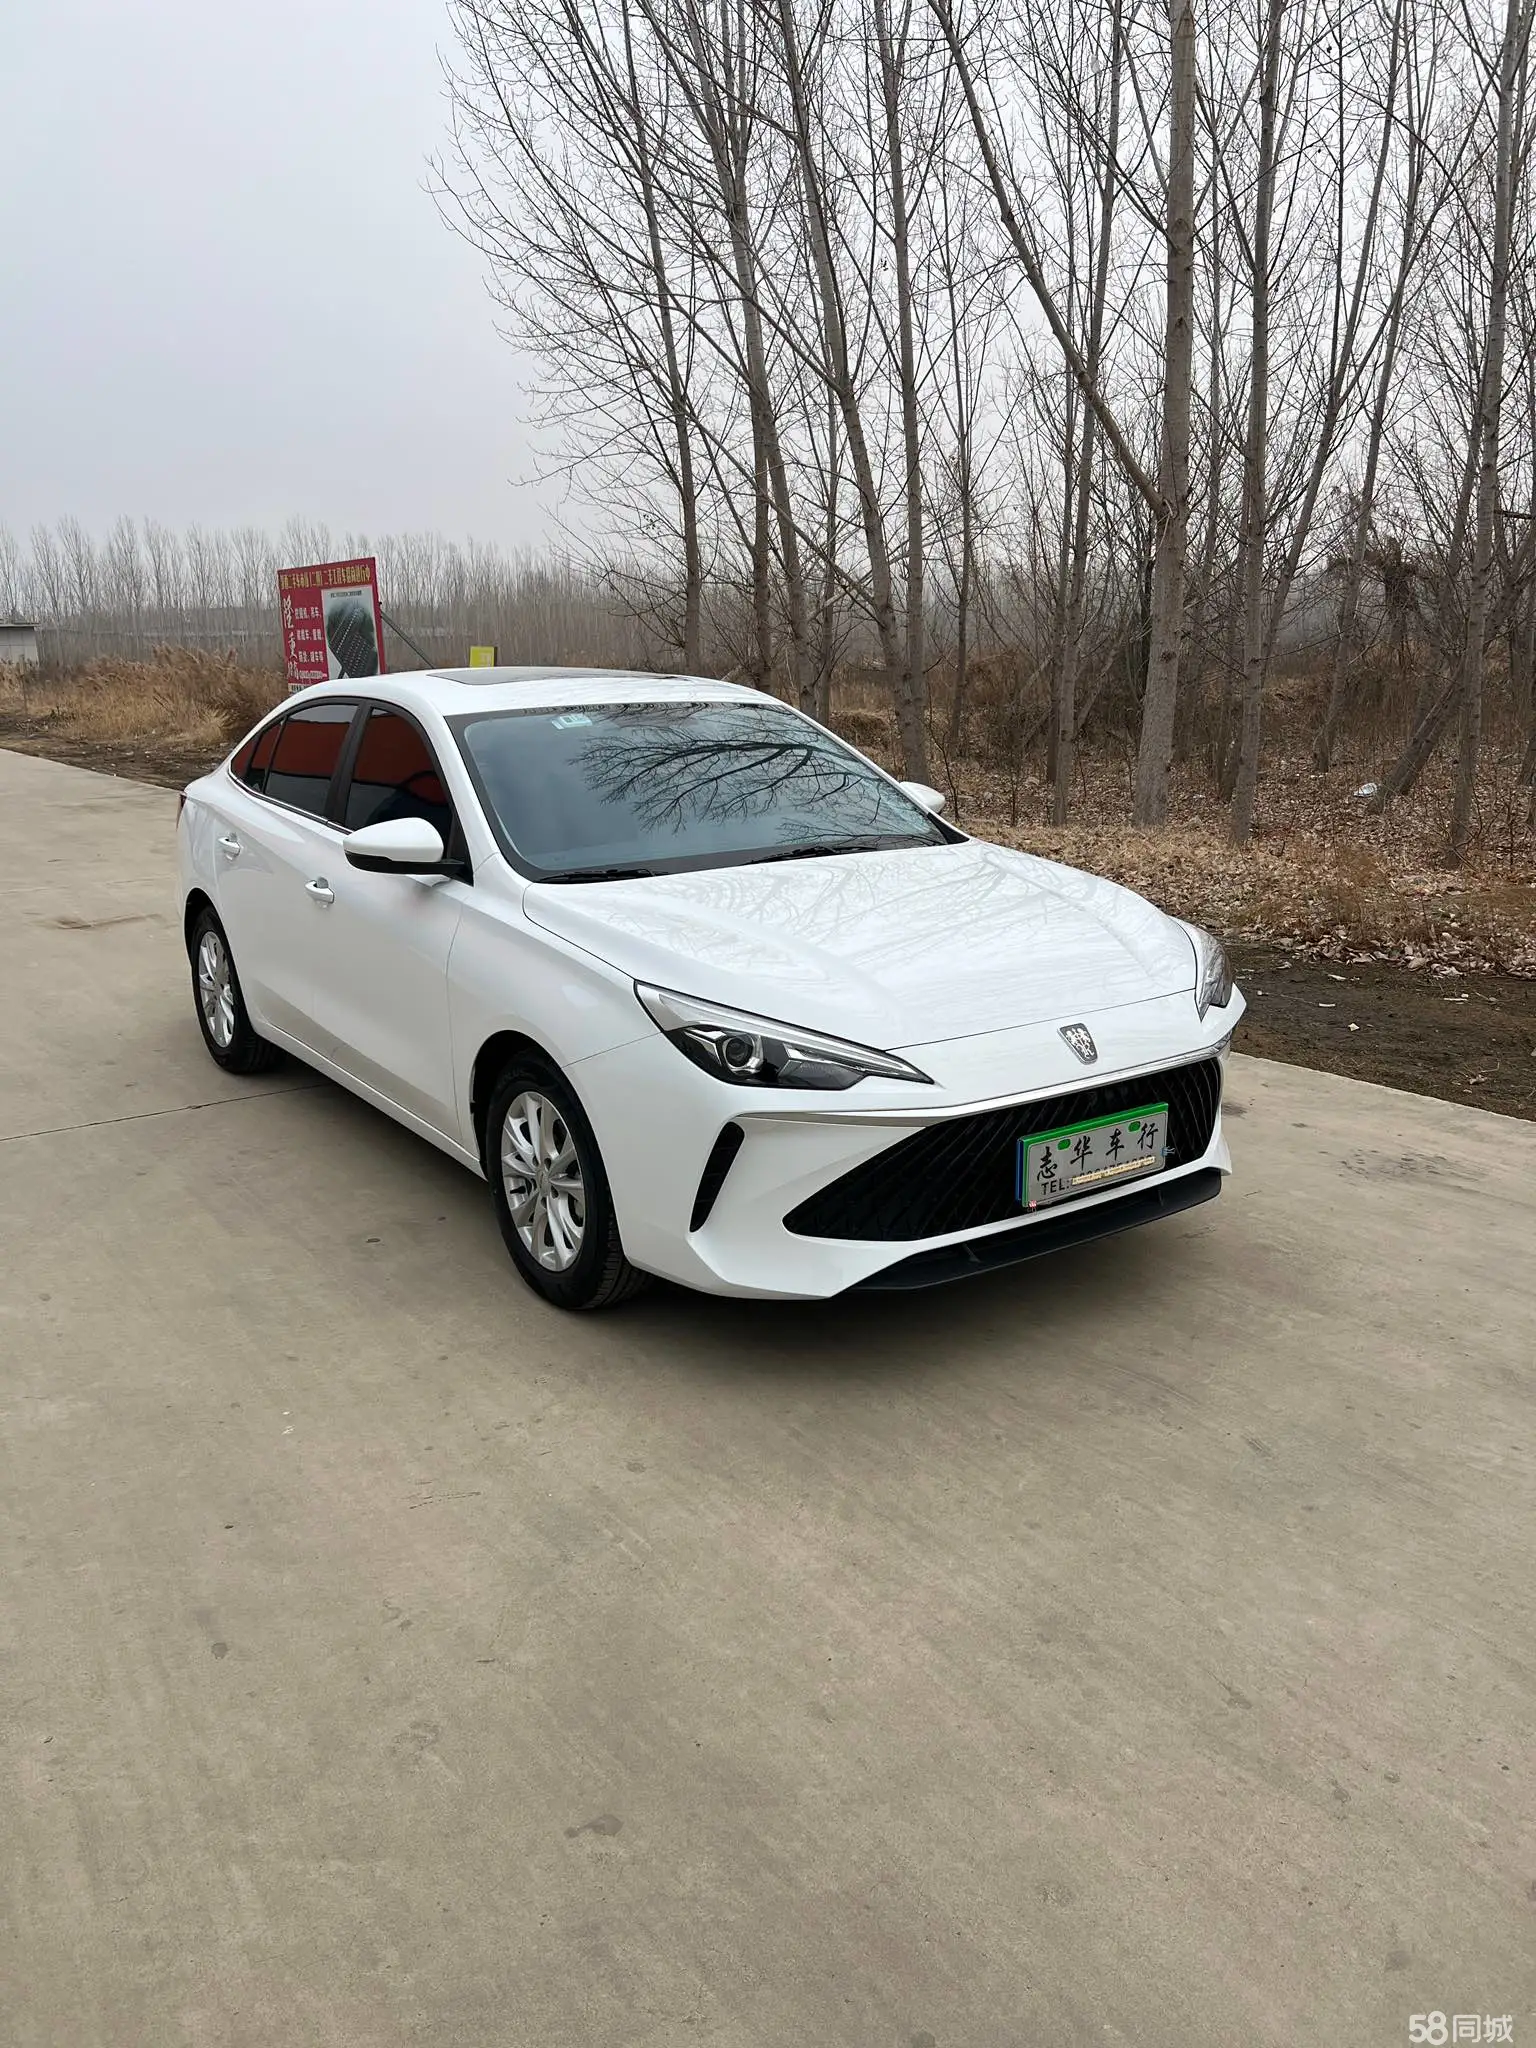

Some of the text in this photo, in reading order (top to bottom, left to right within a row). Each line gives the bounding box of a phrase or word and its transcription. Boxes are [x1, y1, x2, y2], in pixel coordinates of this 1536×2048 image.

[1036, 1122, 1158, 1181] 志华车行
[1041, 1179, 1070, 1195] TEL:
